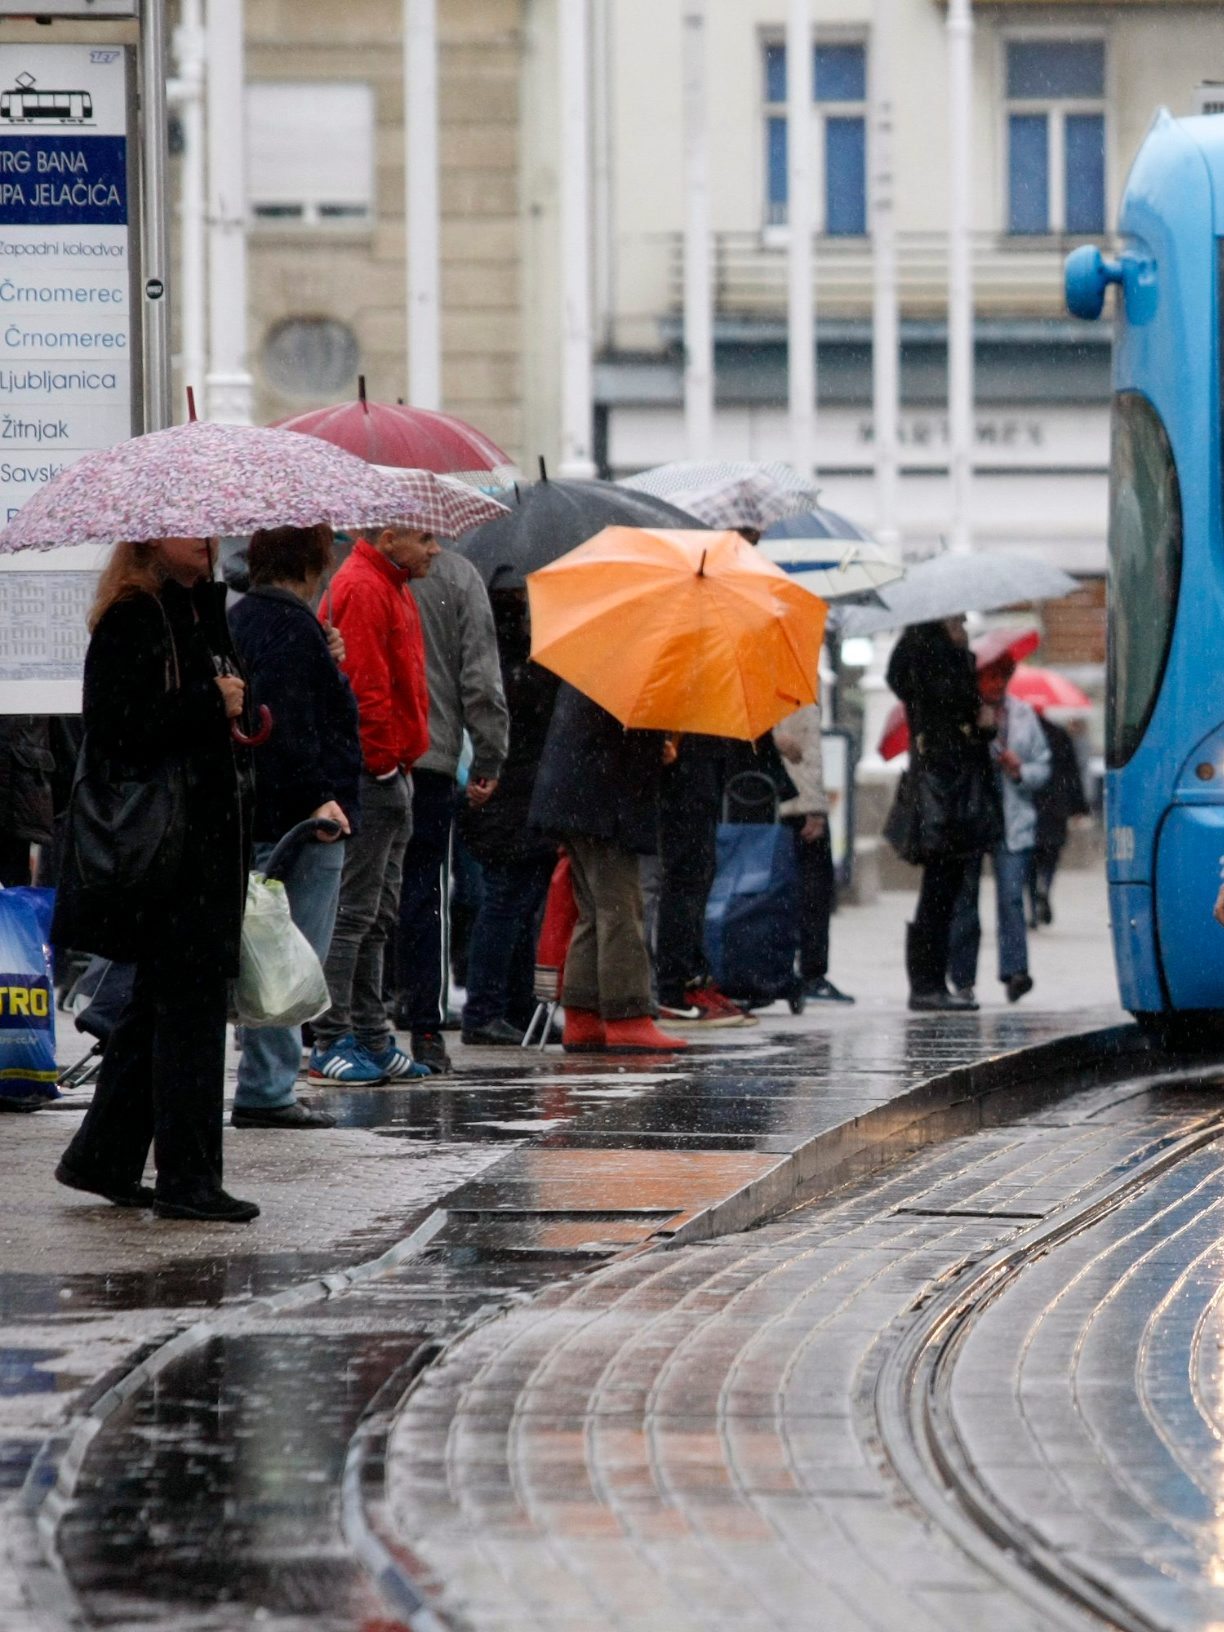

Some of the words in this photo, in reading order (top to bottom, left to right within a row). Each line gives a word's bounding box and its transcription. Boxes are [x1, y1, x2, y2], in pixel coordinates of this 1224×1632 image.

[37, 151, 88, 172] BANA
[30, 177, 121, 206] JELAČIĆA
[63, 242, 124, 256] kolodvor
[0, 279, 123, 302] Črnomerec
[4, 324, 127, 347] Črnomerec
[0, 370, 116, 393] Ljubljanica
[2, 414, 69, 442] Žitnjak
